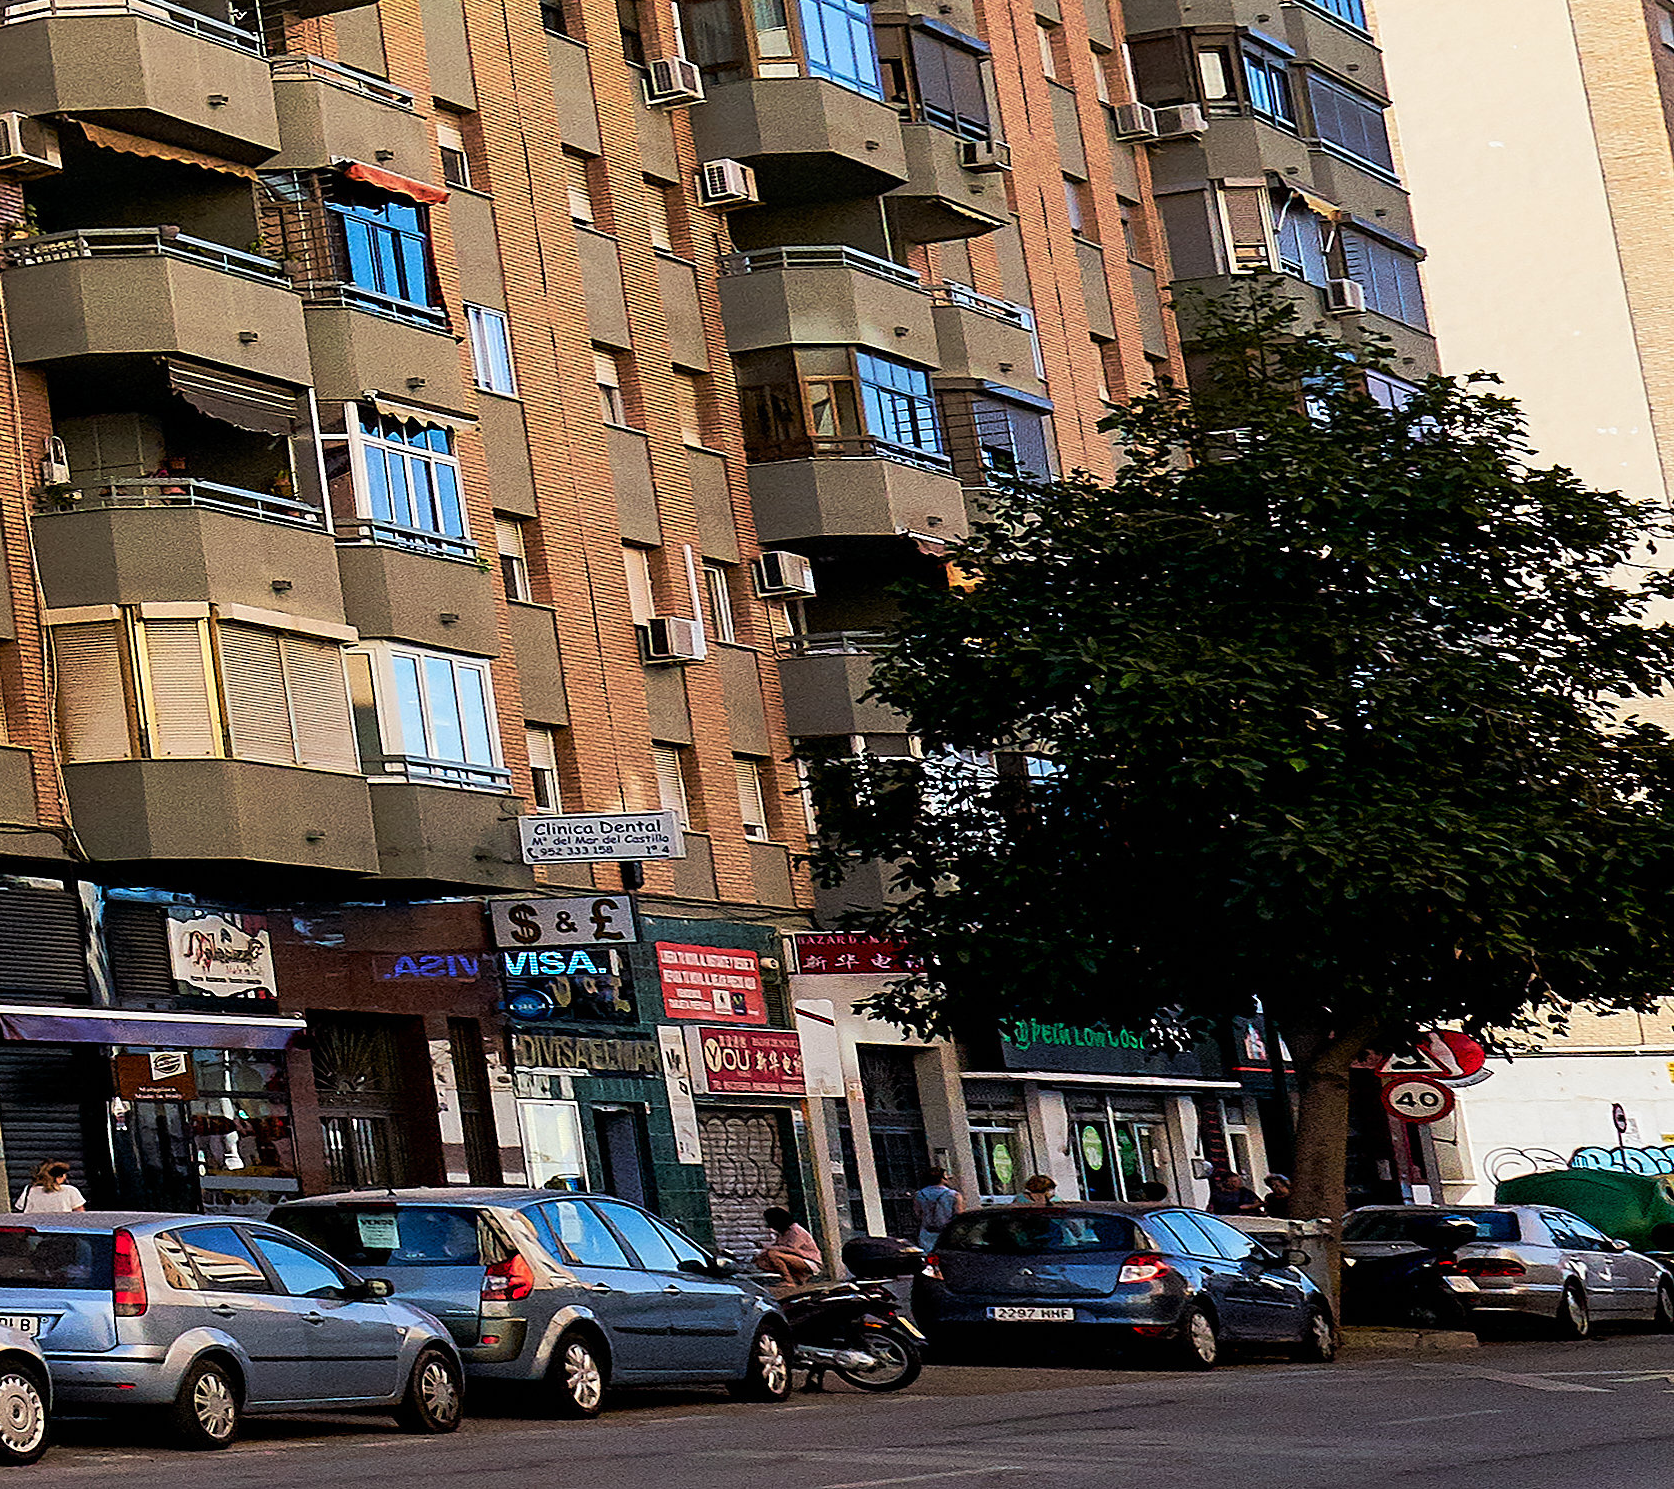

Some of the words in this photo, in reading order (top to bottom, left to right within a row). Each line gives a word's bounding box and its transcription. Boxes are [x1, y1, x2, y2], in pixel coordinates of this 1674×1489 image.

[599, 819, 661, 834] Dental
[553, 836, 571, 845] del
[575, 836, 599, 844] Mar
[602, 835, 620, 844] del
[624, 834, 669, 844] Castillo
[540, 847, 563, 856] 952
[567, 847, 589, 855] 333
[555, 910, 579, 933] &
[1395, 1091, 1439, 1107] 40
